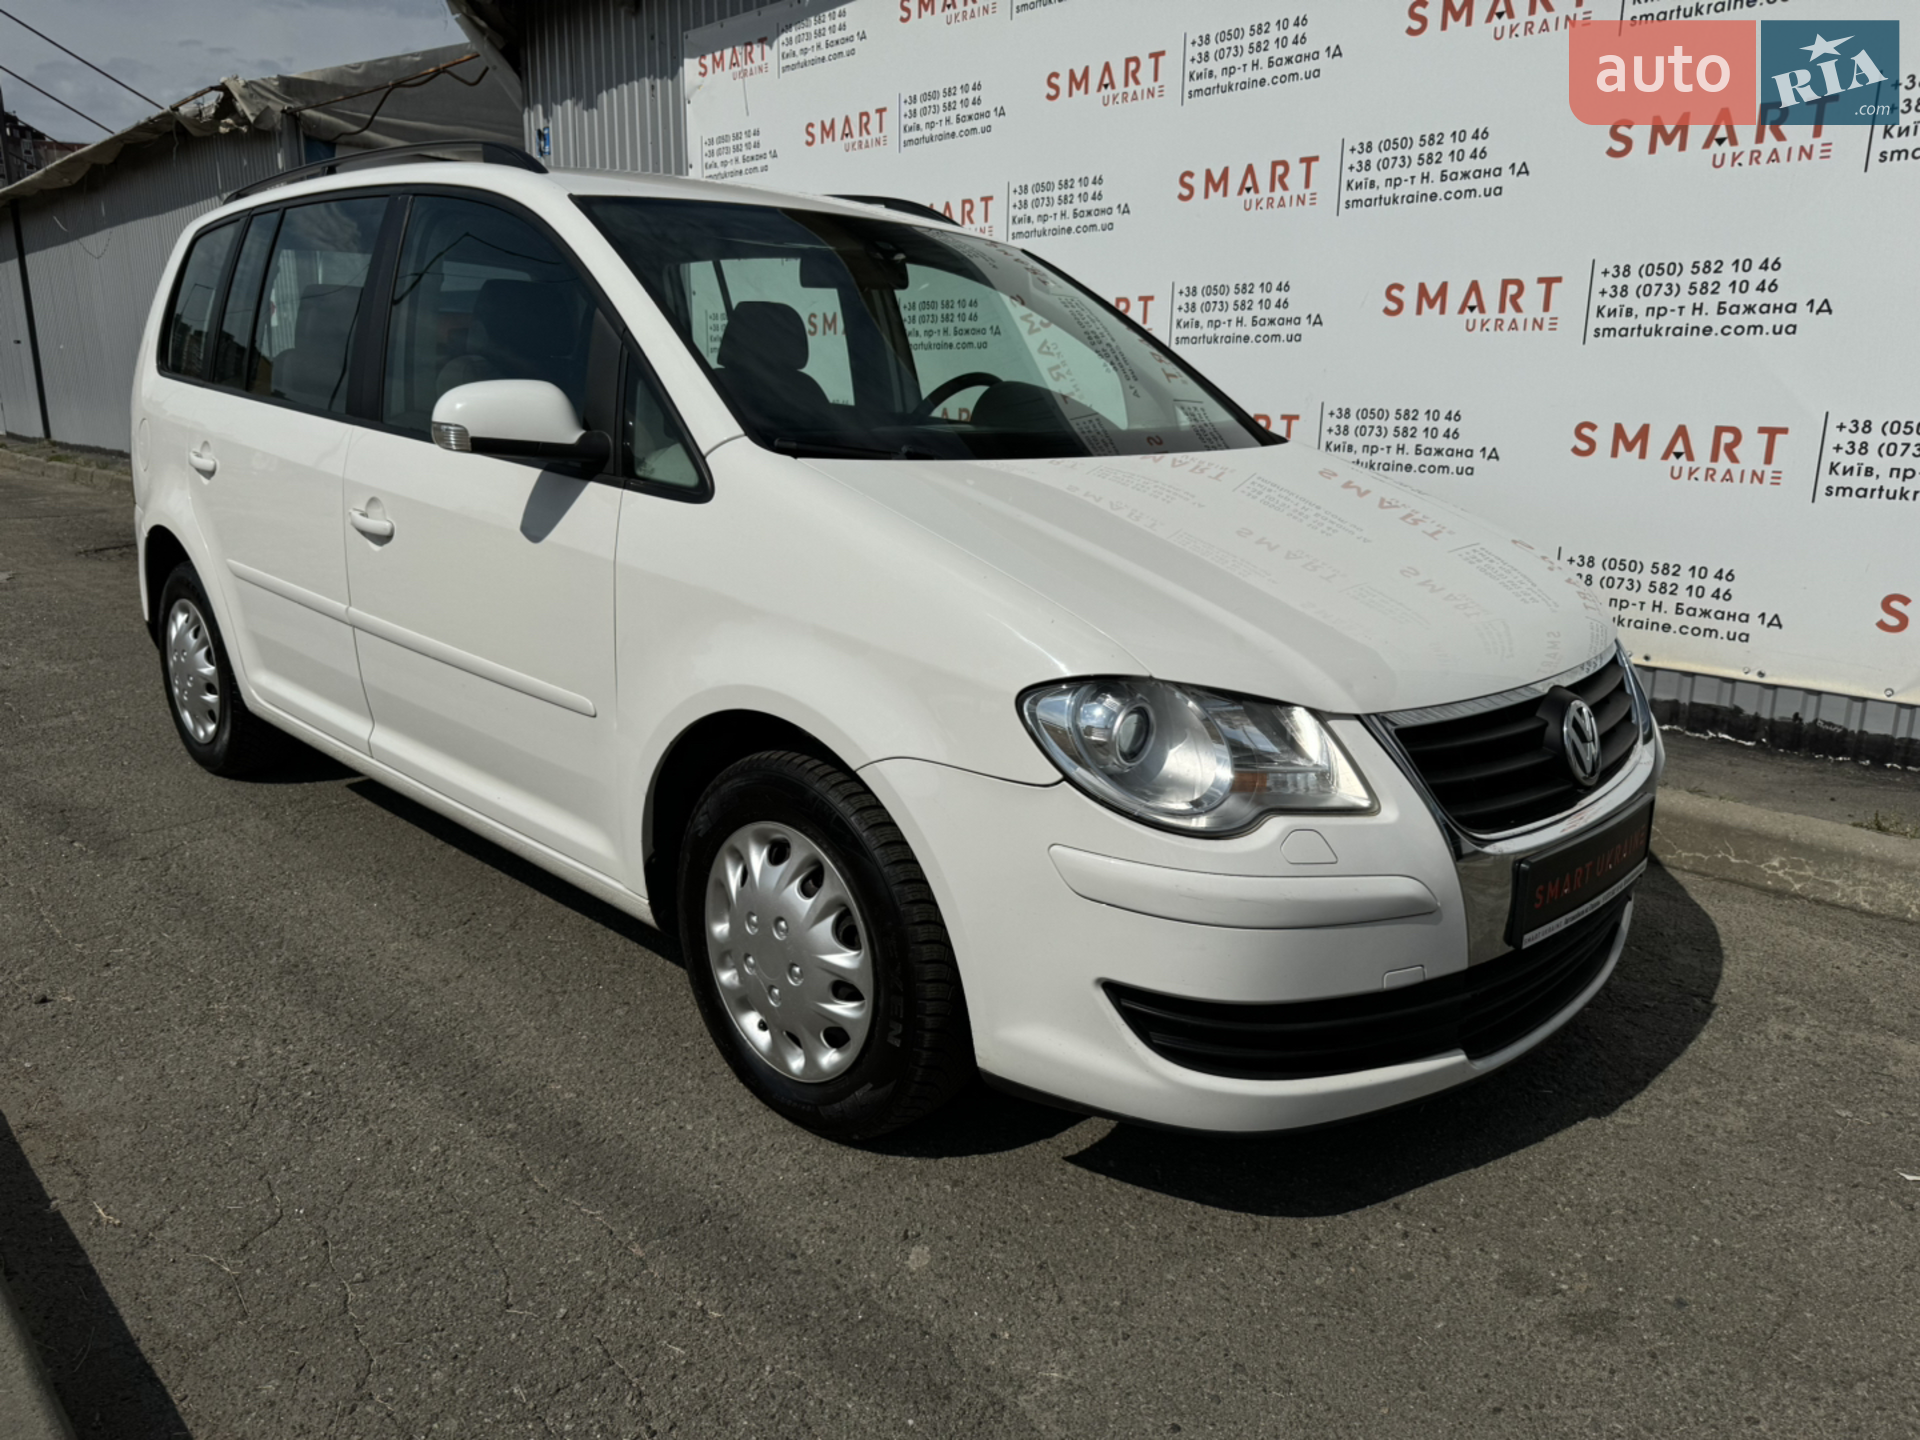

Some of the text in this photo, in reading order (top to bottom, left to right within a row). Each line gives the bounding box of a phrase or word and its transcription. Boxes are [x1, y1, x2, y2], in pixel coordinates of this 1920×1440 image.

[946, 2, 997, 25] UKRAINE
[1493, 10, 1592, 41] UKRAINE
[1190, 14, 1307, 47] +38 (050) 582 10 46
[698, 37, 768, 78] SMART
[1189, 32, 1306, 63] +38 (073) 582 10 46
[1045, 50, 1166, 101] SMART
[1188, 44, 1342, 81] Київ, пр-т Н. Бажана 1Д
[1102, 84, 1165, 106] UKRAINE
[1187, 68, 1320, 99] smartukraine.com.ua
[804, 107, 888, 147] SMART
[1349, 126, 1489, 154] +38 (050) 582 10 46
[1605, 95, 1840, 159] SMART
[843, 135, 888, 153] UKRAINE
[1711, 142, 1833, 169] UKRAINE
[1347, 146, 1487, 172] +38 (073) 582 10 46
[1177, 155, 1320, 202] SMART
[1346, 161, 1529, 191] Київ, пр-т Н. Бажана 1Д
[1243, 192, 1317, 211] UKRAINE
[1344, 185, 1502, 209] smartukraine.com.ua
[928, 195, 994, 226] ART
[1601, 256, 1781, 278] +38 (050) 582 10 46
[1178, 280, 1290, 297] +38 (050) 582 10 46
[1382, 276, 1563, 317] SMART
[1598, 278, 1778, 298] +38 (073) 582 10 46
[1177, 297, 1288, 313] +38 (073) 582 10 46
[1596, 298, 1832, 319] Київ, пр-т Н. Бажана 1Д
[1175, 318, 1202, 328] Київ,
[1206, 318, 1232, 330] пр-т
[1251, 315, 1301, 326] Бажана
[1306, 313, 1323, 326] 1Д
[1464, 316, 1558, 334] UKRAINE
[1593, 323, 1797, 337] smartukraine.com.ua
[1174, 332, 1301, 345] smartukraine.com.ua
[1328, 407, 1461, 422] +38 (050) 582 10 46
[1836, 419, 1872, 434] +38
[1327, 424, 1459, 439] +38 (073) 582 10 46
[1571, 420, 1789, 466] SMART
[1325, 440, 1499, 461] Київ, пр-т Н. Бажана 1Д
[1832, 440, 1869, 456] +38
[1669, 465, 1783, 486] UKRAINE
[1828, 461, 1880, 480] Київ,
[1566, 554, 1735, 582] +38 (050) 582 10 46
[1599, 575, 1732, 601] (073) 582 10 46
[1608, 597, 1782, 629] пр-т Н. Бажана 1Д
[1875, 593, 1912, 634] S
[1534, 860, 1594, 909] SMART
[1596, 825, 1647, 877] UKRAINE
